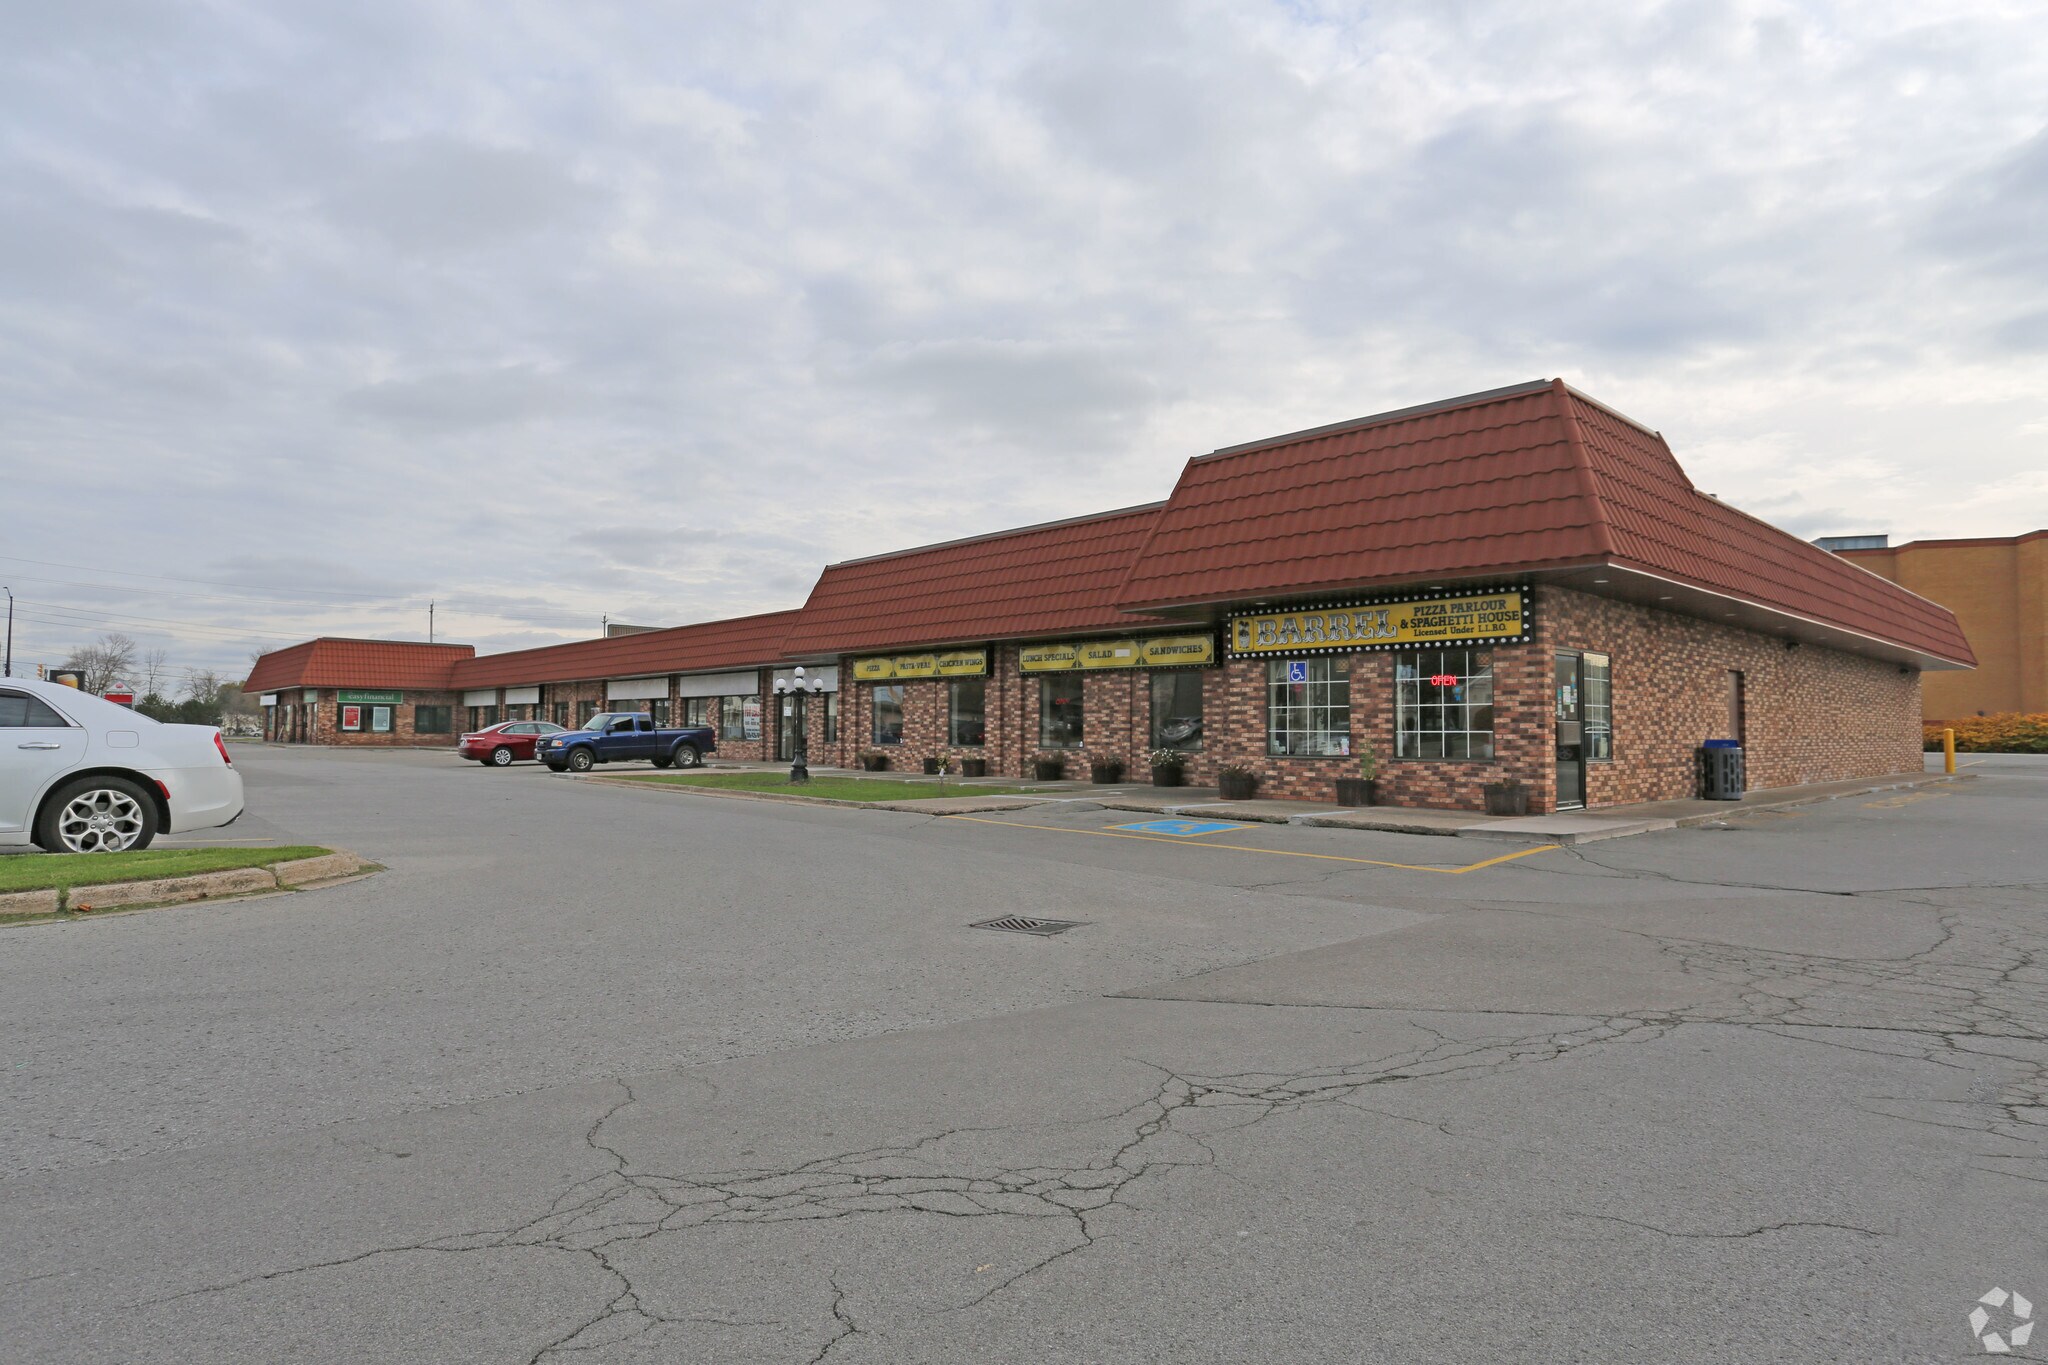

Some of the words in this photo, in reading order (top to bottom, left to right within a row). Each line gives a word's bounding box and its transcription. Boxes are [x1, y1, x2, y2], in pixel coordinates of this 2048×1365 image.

[1413, 604, 1447, 616] PIZZA
[1450, 599, 1507, 614] PARLOUR
[1400, 618, 1408, 629] &
[1410, 613, 1474, 629] SPAGHETTI
[1477, 610, 1520, 623] HOUSE
[1256, 609, 1398, 647] BARREL
[1413, 627, 1447, 637] Licensed
[1450, 625, 1474, 635] Under
[1088, 649, 1113, 659] SALAD
[1149, 645, 1203, 656] SANDWICHES
[1022, 653, 1042, 662] LUNCH
[1044, 651, 1075, 662] SPECIALS
[964, 658, 983, 667] WINGS
[1431, 675, 1457, 686] OPEN
